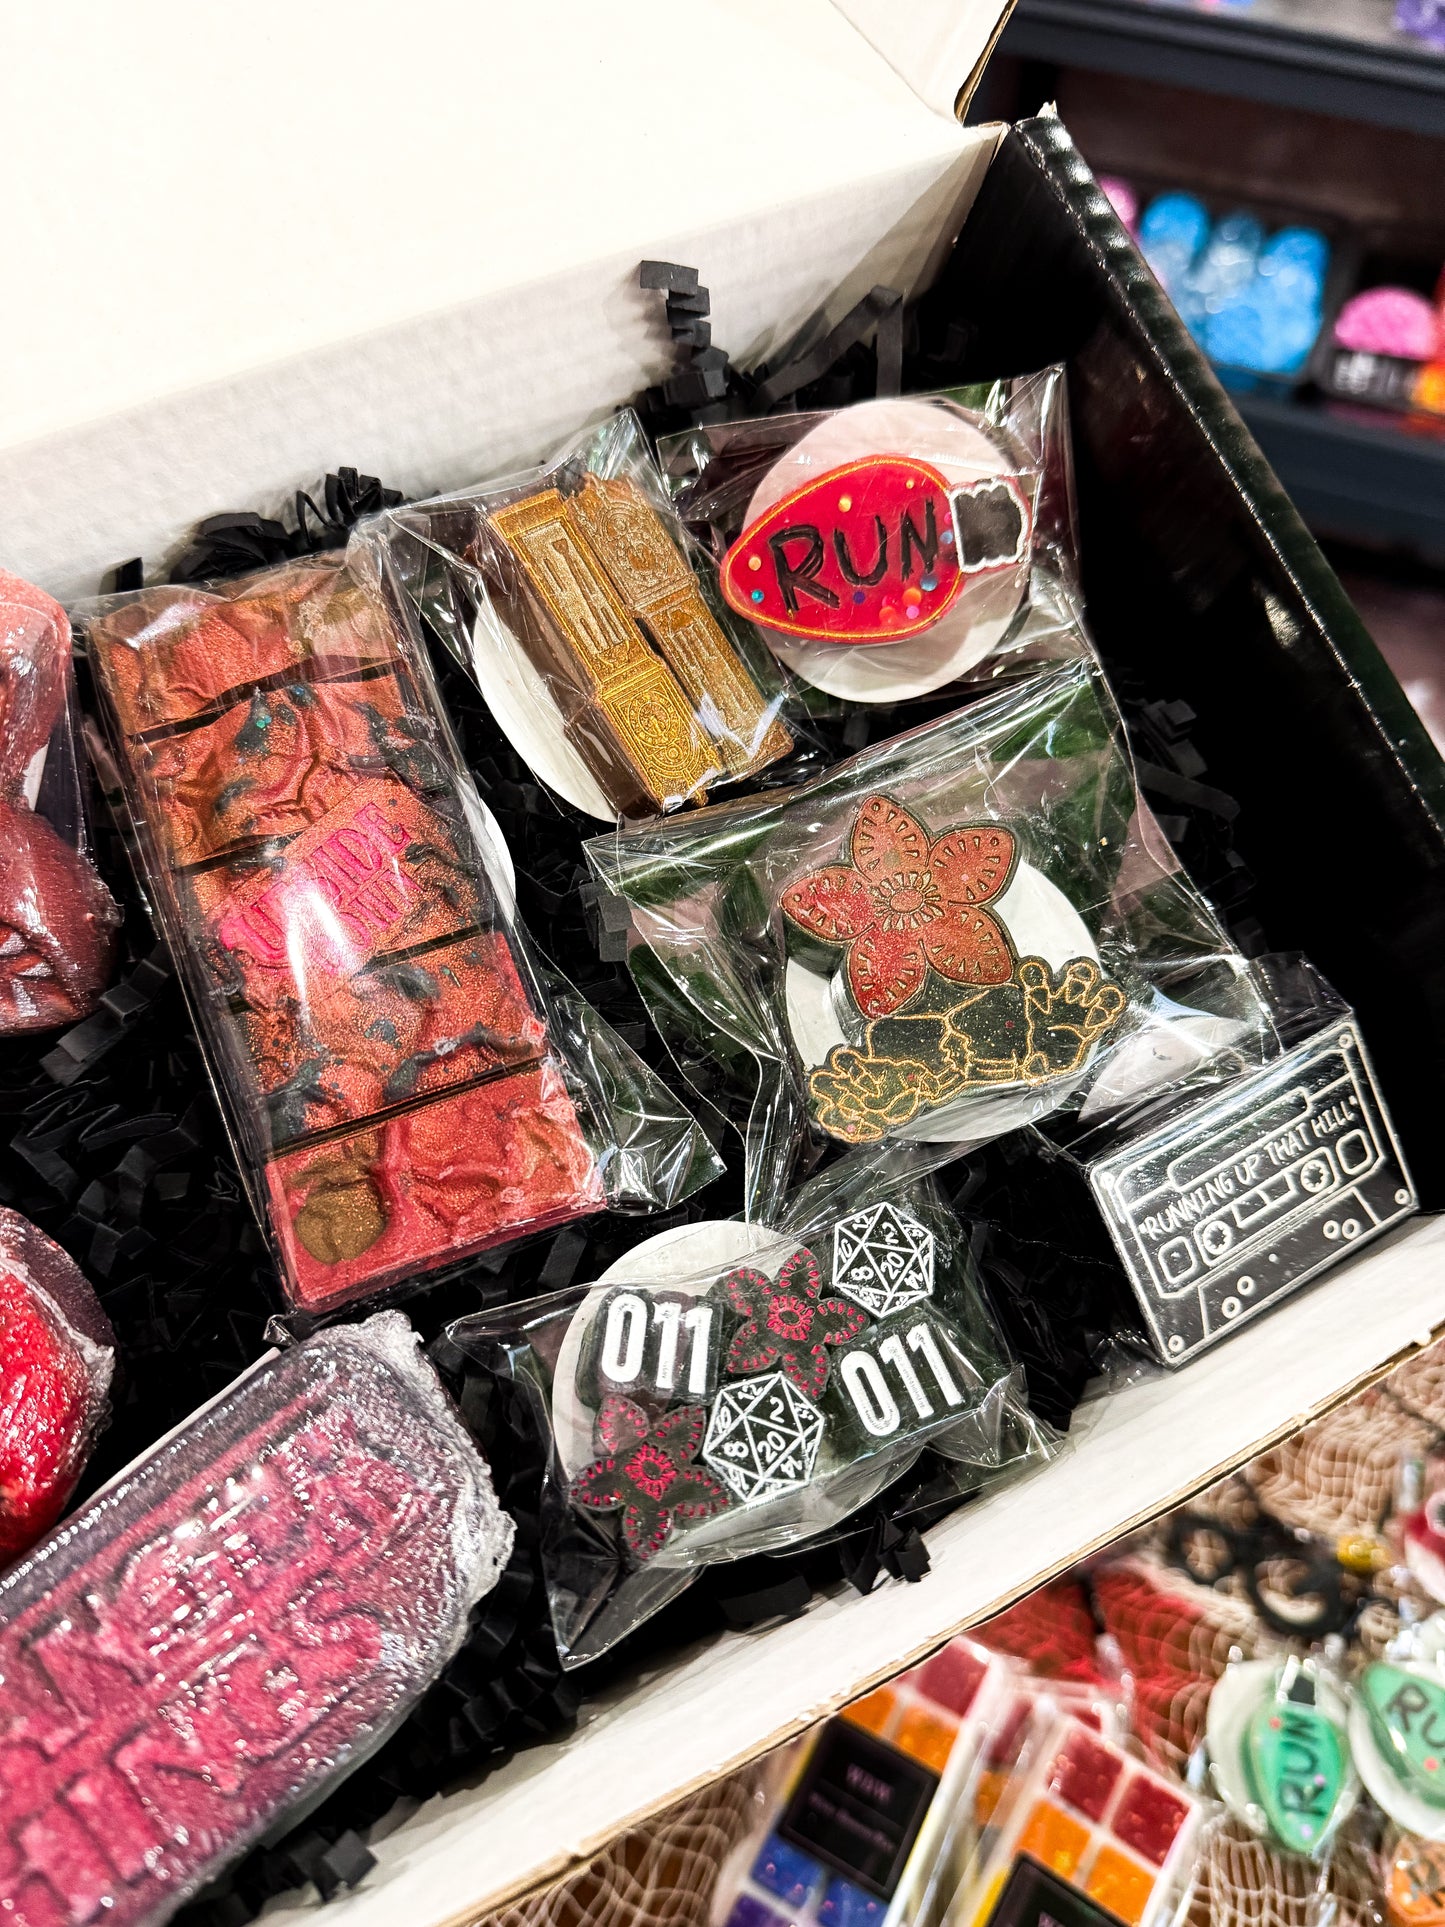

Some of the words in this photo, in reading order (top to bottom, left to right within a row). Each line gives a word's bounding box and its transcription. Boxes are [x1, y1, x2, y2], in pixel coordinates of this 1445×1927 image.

[768, 496, 939, 618] RUN
[1236, 1156, 1265, 1186] UP
[1263, 1124, 1312, 1166] THAT
[882, 1222, 899, 1244] 2
[851, 1266, 874, 1280] 8
[880, 1252, 905, 1280] 20
[601, 1293, 713, 1395] 011
[738, 1384, 764, 1400] 12
[841, 1322, 965, 1436] 011
[769, 1397, 785, 1423] 2
[724, 1441, 749, 1458] 8
[757, 1431, 786, 1463] 20
[1279, 1711, 1327, 1817] RUN
